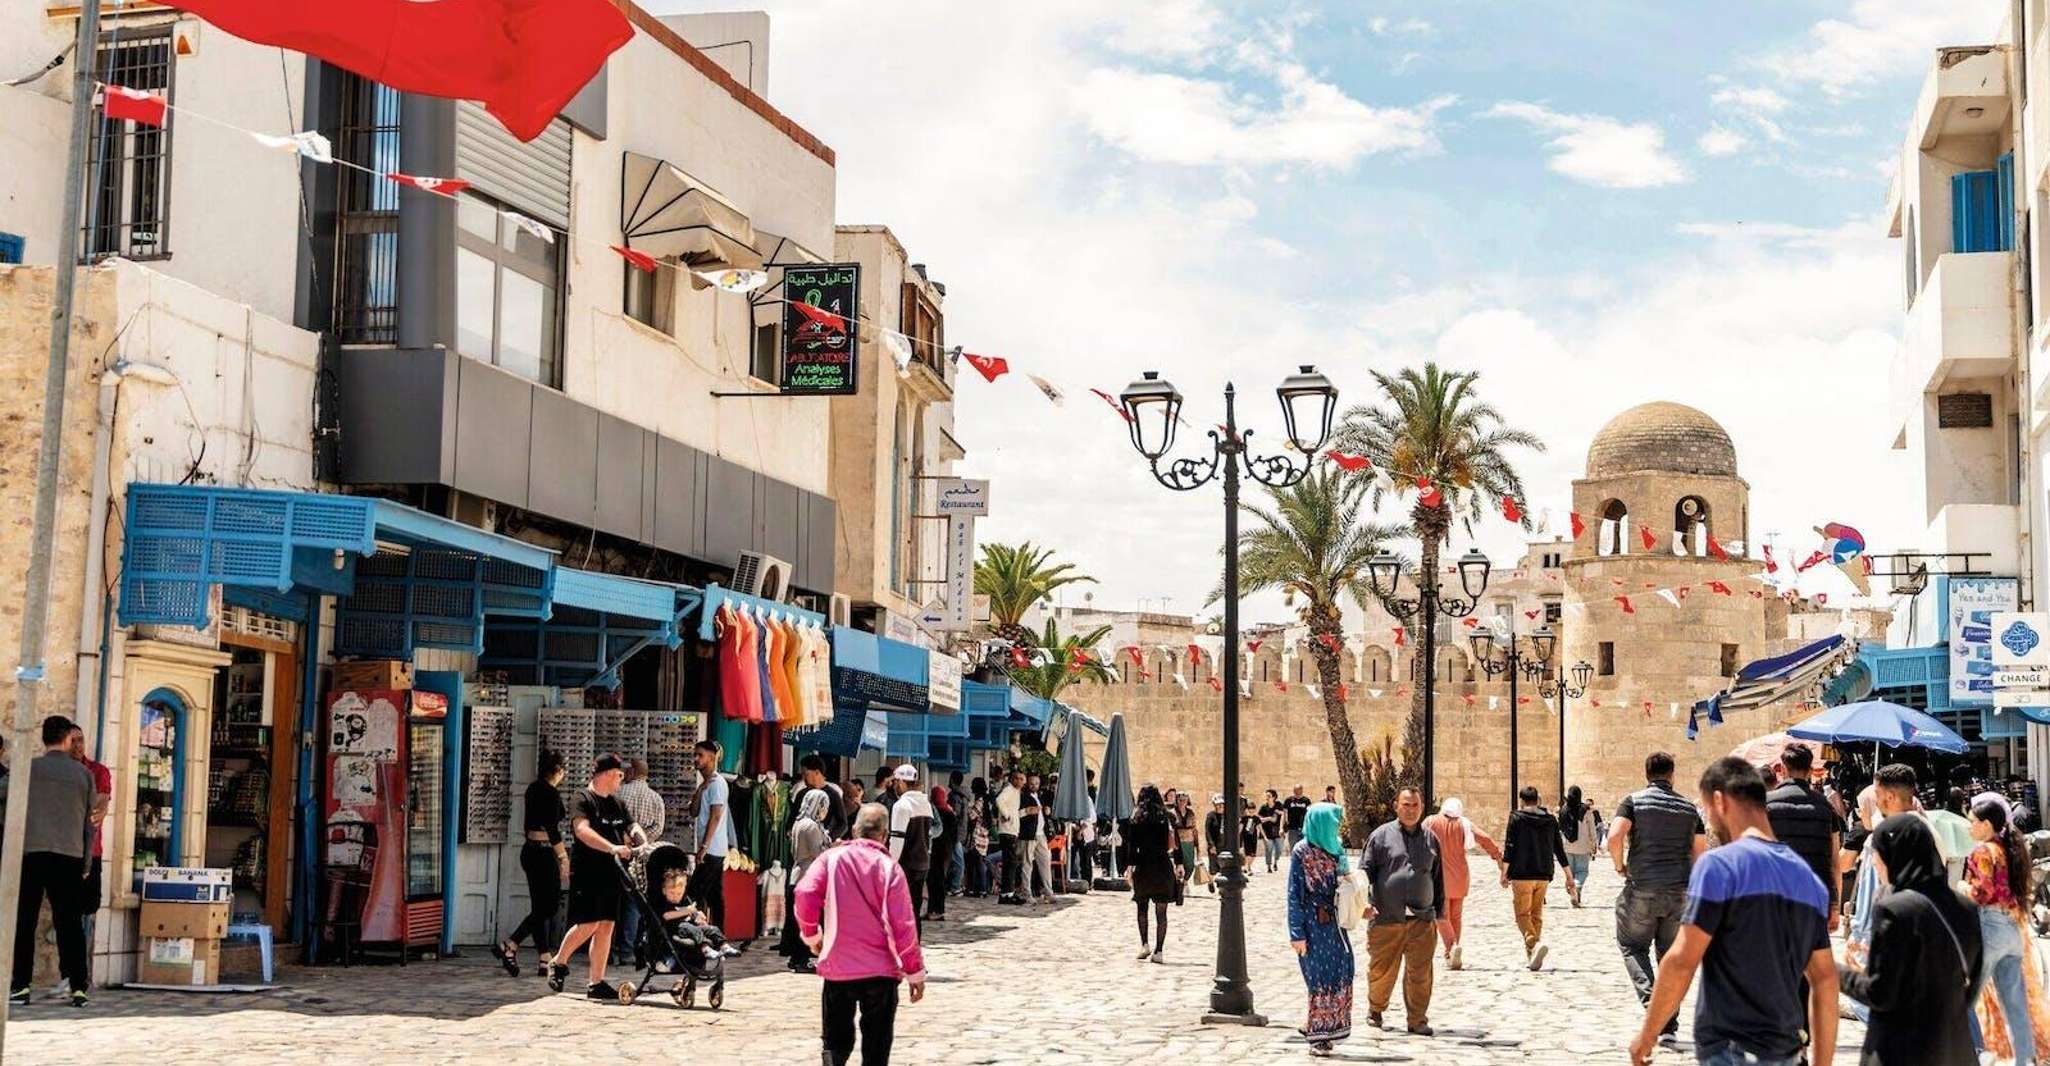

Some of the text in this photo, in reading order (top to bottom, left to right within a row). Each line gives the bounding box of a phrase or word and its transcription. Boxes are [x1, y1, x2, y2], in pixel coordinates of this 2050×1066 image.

[788, 273, 817, 286] طبية
[794, 363, 841, 375] Analyses
[791, 375, 844, 386] Médicales
[944, 483, 980, 498] مطعم
[940, 498, 985, 509] Restaurant
[2000, 674, 2041, 683] CHANGE
